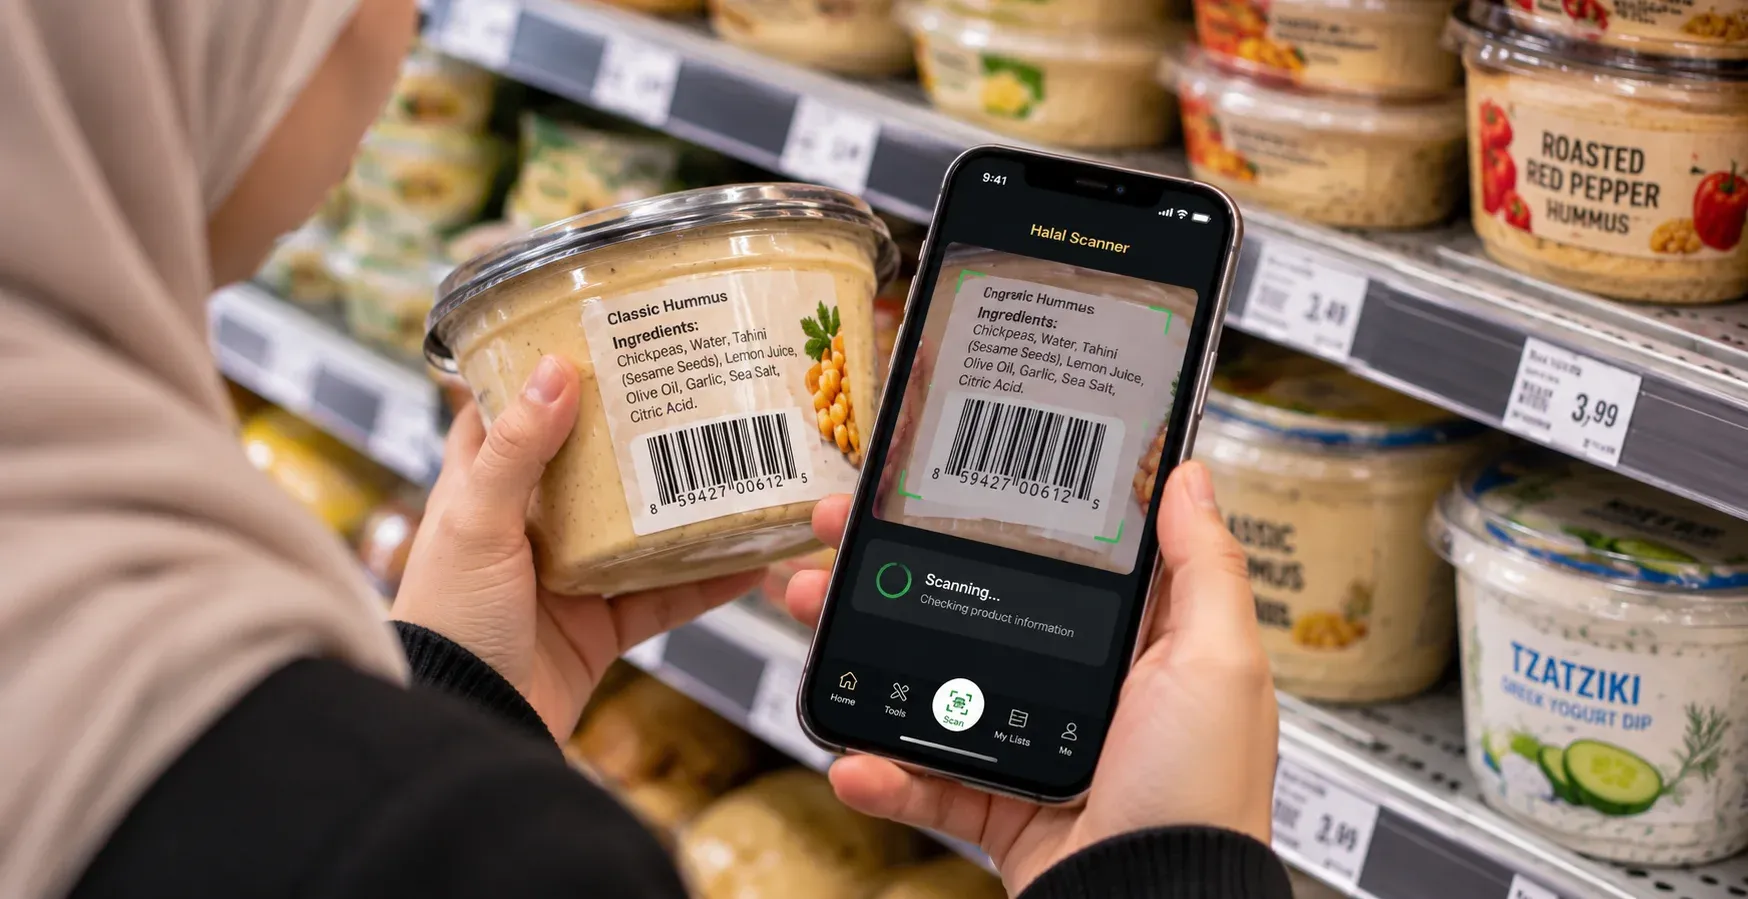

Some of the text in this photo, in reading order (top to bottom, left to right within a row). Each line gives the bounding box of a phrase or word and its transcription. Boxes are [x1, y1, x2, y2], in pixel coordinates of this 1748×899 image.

[1542, 130, 1645, 175] ROASTED
[982, 172, 1007, 186] 9:41
[1526, 157, 1661, 209] RED PEPPER
[1546, 198, 1630, 235] HUMMUS
[1030, 224, 1131, 254] Halal Scanner
[607, 291, 728, 326] Classic Hummus
[612, 321, 699, 350] Ingredients:
[617, 328, 767, 368] Chickpeas, Water, Tahini
[972, 324, 1119, 360] Chickpeas, Water, Tahini
[622, 345, 798, 387] (Sesame Seeds), Lemon Juice,
[963, 357, 1116, 397] Olive Oil, Garlic, Sea Salt,
[967, 340, 1144, 387] (Sesame Seeds), Lemon Juice,
[625, 364, 780, 405] Olive Oil, Garlic, Sea Salt,
[958, 374, 1024, 395] Citric Acid.
[630, 398, 698, 423] Citric Acid.
[1571, 393, 1619, 428] 3,99
[650, 473, 808, 515] 8 59427 00612 5
[932, 468, 940, 480] 8
[959, 470, 1010, 492] 59427
[1018, 481, 1072, 504] 00612
[925, 573, 1000, 602] Scanning...
[920, 594, 1075, 638] Checking product information
[1510, 641, 1641, 706] TZATZIKI
[830, 693, 856, 706] Home
[885, 705, 906, 718] Tools
[1550, 698, 1618, 728] YOGURT
[1622, 713, 1653, 731] DIP
[943, 715, 965, 727] Scan
[993, 730, 1031, 747] My Lists
[1058, 746, 1073, 757] Me
